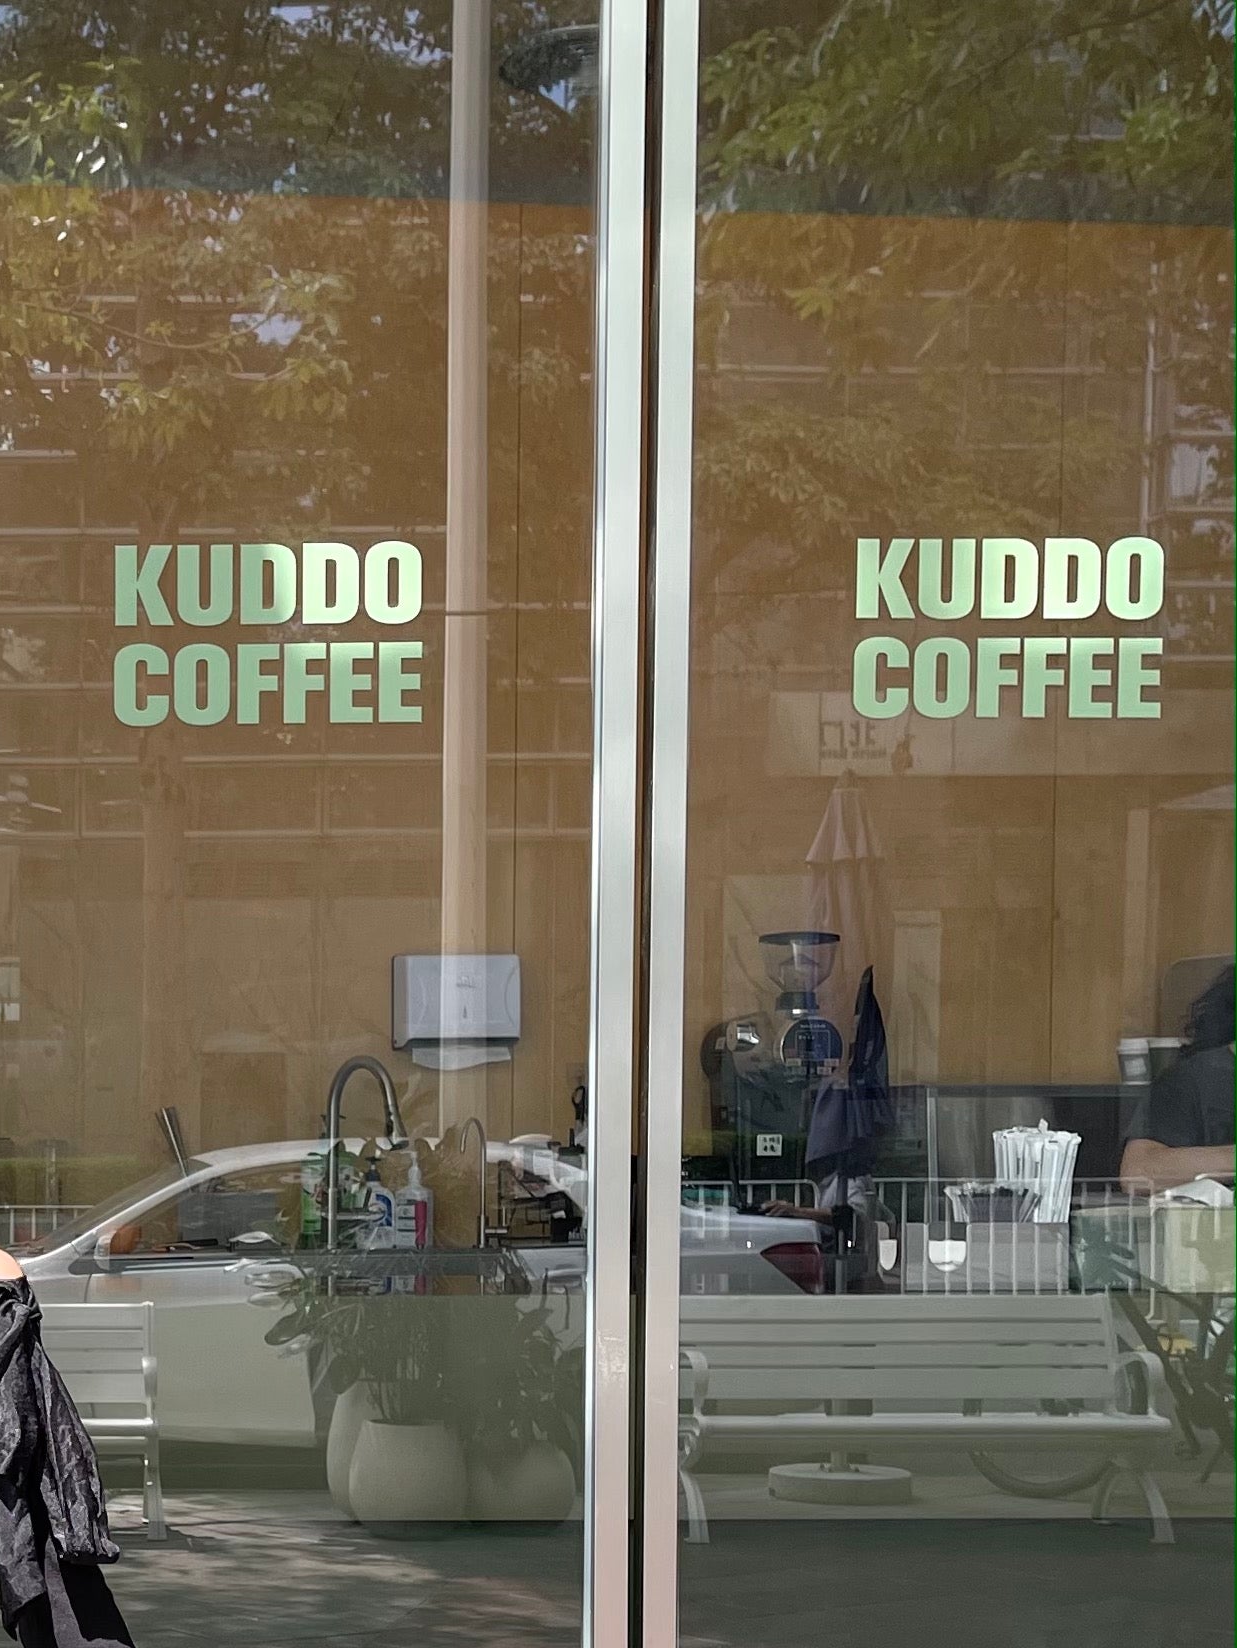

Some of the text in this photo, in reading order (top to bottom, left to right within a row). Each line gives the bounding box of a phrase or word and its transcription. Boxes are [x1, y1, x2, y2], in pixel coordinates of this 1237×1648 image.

[114, 540, 423, 627] KUDDO
[855, 536, 1164, 620] KUDDO
[114, 641, 423, 727] COFFEE
[853, 636, 1163, 719] COFFEE
